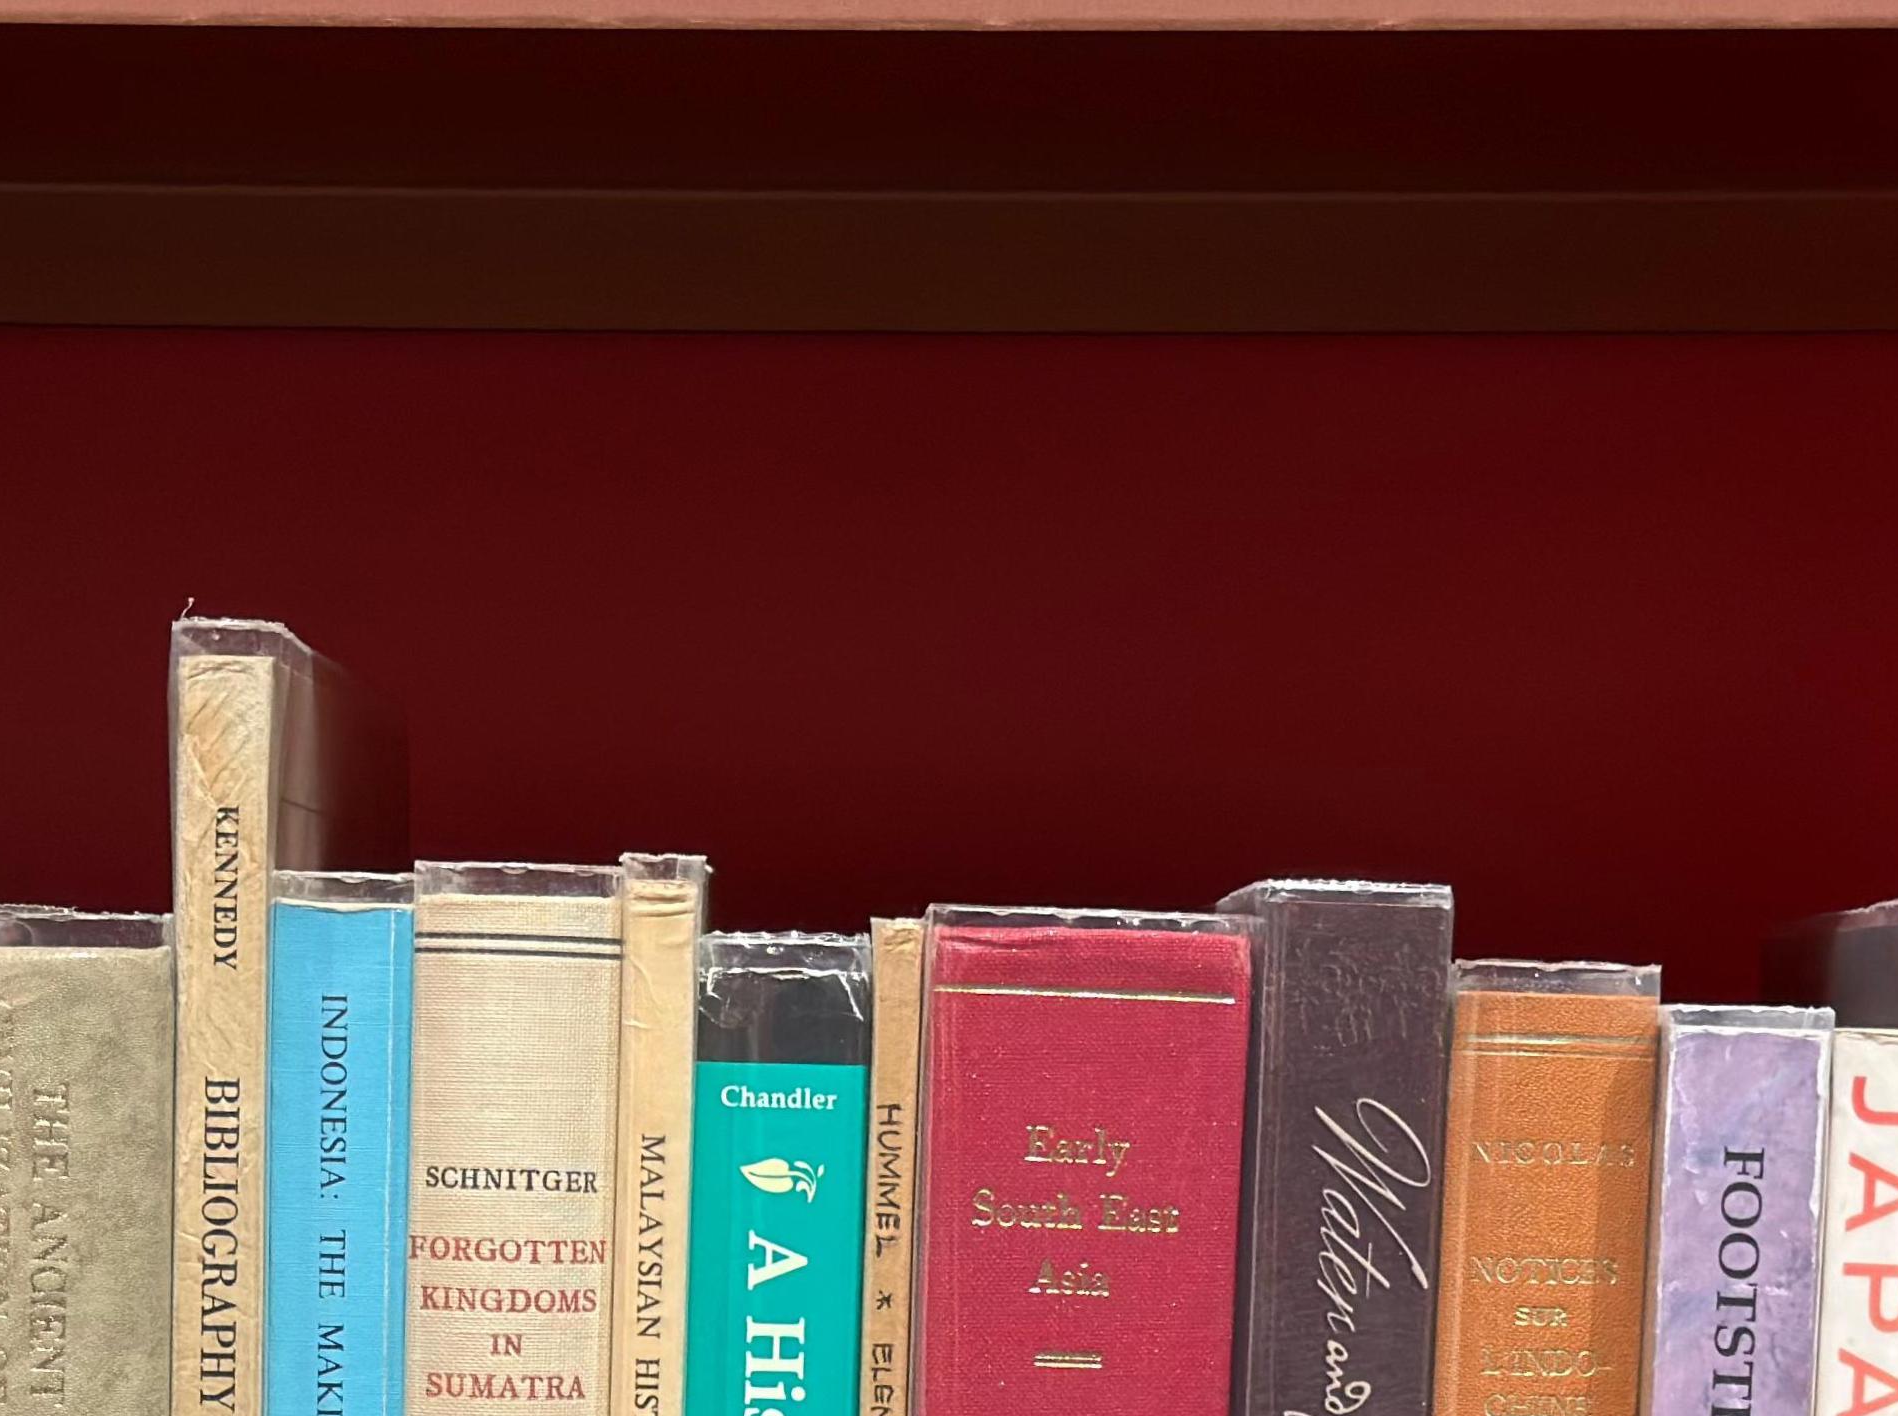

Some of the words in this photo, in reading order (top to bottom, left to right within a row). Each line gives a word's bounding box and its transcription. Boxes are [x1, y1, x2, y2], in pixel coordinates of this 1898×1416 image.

[213, 806, 240, 971] KENNEDY
[720, 1085, 838, 1111] Chandler
[1024, 1126, 1130, 1176] Early
[424, 1166, 598, 1194] SCHNITGER
[875, 1104, 902, 1257] HUMMEL
[971, 1189, 1083, 1230] South
[1098, 1195, 1180, 1234] East
[1311, 1097, 1432, 1333] Water
[197, 1077, 240, 1413] BIBLIOGRAPHY
[408, 1233, 606, 1265] FORGOTTEN
[636, 1134, 666, 1339] MALAYSIAN
[319, 1230, 347, 1299] THE
[747, 1230, 809, 1290] A
[1029, 1259, 1109, 1297] Asia
[1471, 1256, 1620, 1286] NOTICES
[419, 1286, 597, 1314] KINGDOMS
[1514, 1308, 1568, 1327] SUR
[425, 1372, 587, 1400] SUMATRA
